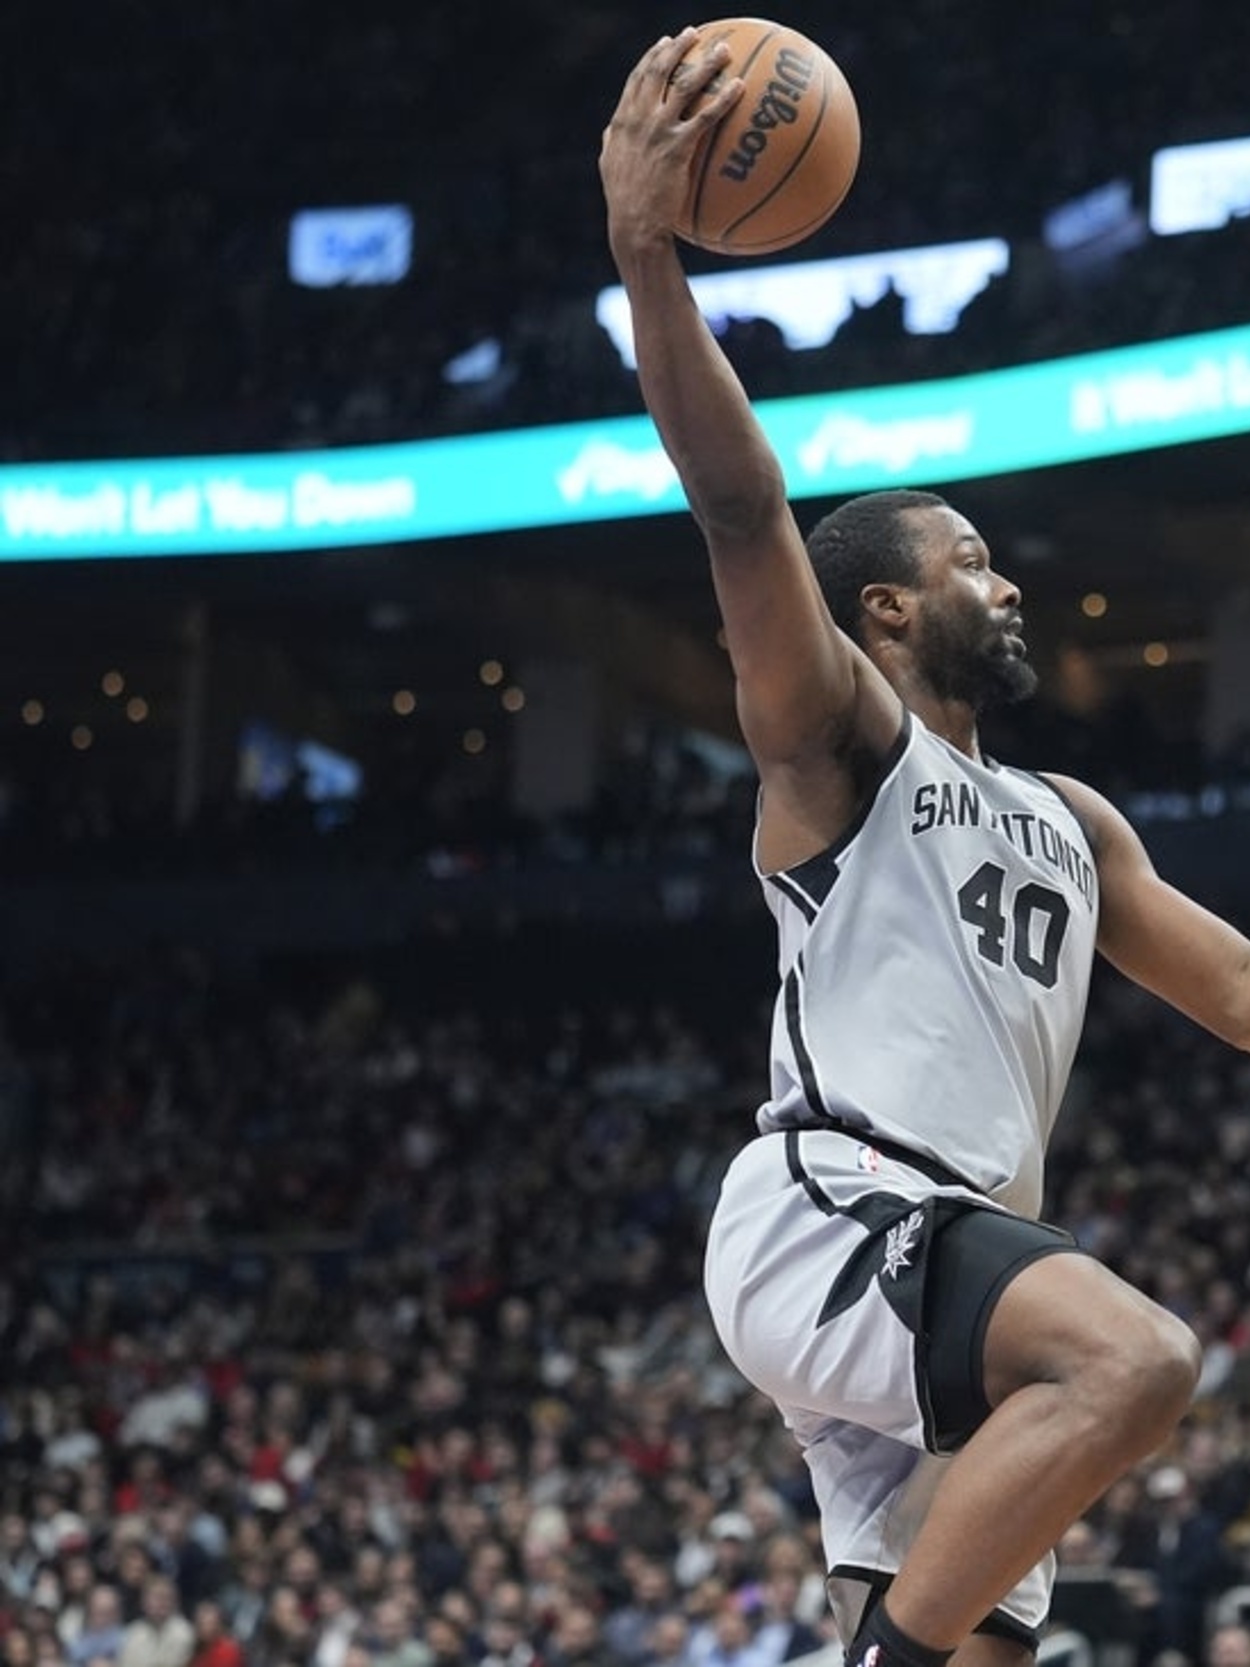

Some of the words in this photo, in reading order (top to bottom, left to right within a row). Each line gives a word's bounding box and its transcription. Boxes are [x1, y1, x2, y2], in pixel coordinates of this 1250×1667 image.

[719, 47, 815, 182] Wilson
[911, 782, 981, 836] SAN
[957, 860, 1071, 990] 40
